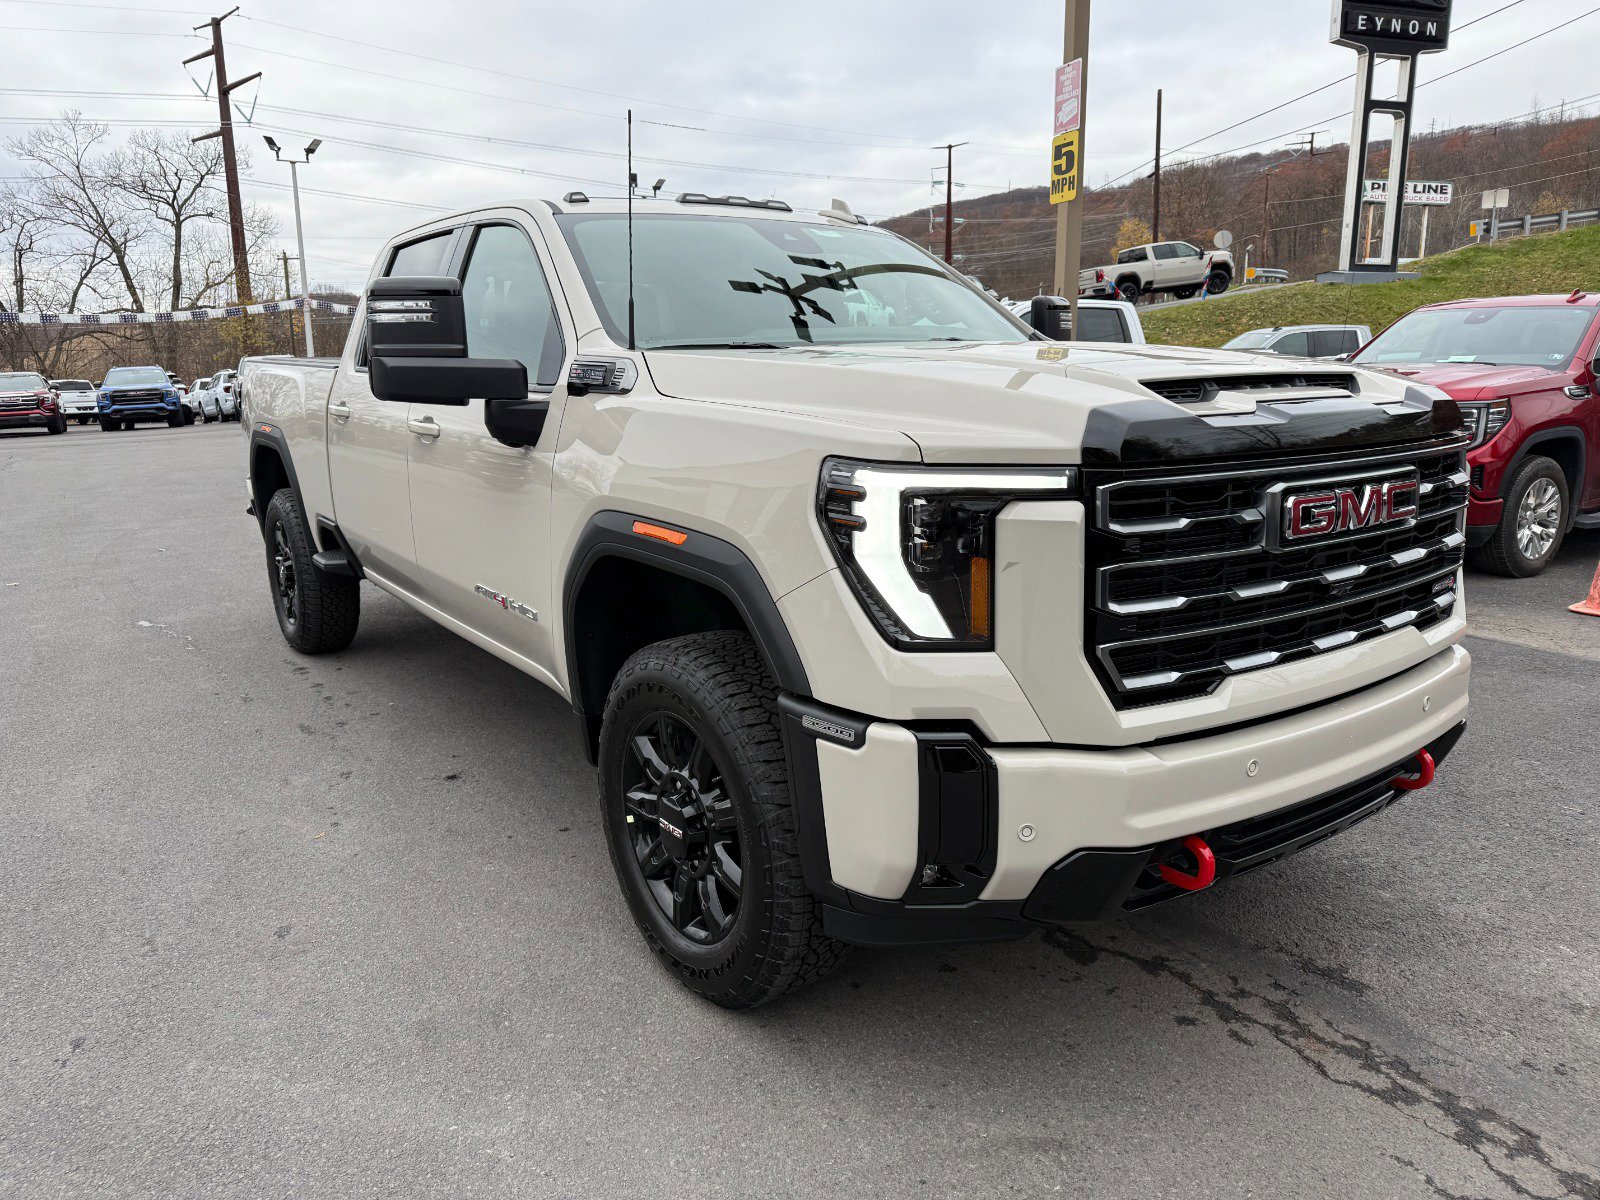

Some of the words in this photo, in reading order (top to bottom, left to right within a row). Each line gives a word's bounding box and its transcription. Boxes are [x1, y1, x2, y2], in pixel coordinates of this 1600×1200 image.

[1357, 15, 1437, 36] EYNON
[1053, 141, 1075, 176] 5
[1051, 175, 1075, 195] MPH
[1413, 184, 1449, 194] LINE
[1284, 479, 1417, 539] GMC
